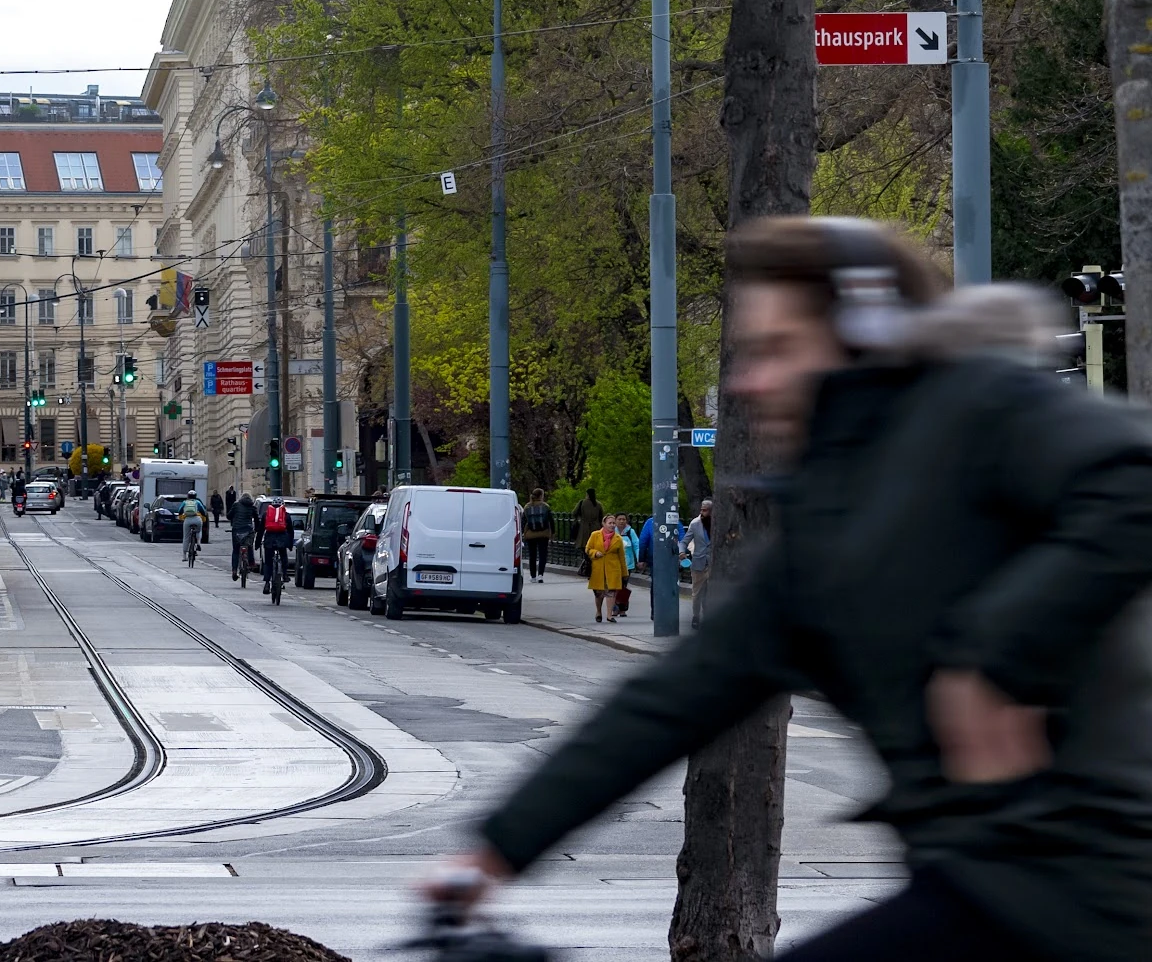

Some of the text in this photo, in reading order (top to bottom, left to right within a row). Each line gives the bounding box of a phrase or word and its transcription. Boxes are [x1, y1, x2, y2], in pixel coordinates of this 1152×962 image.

[815, 27, 903, 50] thauspark
[443, 176, 454, 190] E
[694, 432, 710, 443] WC
